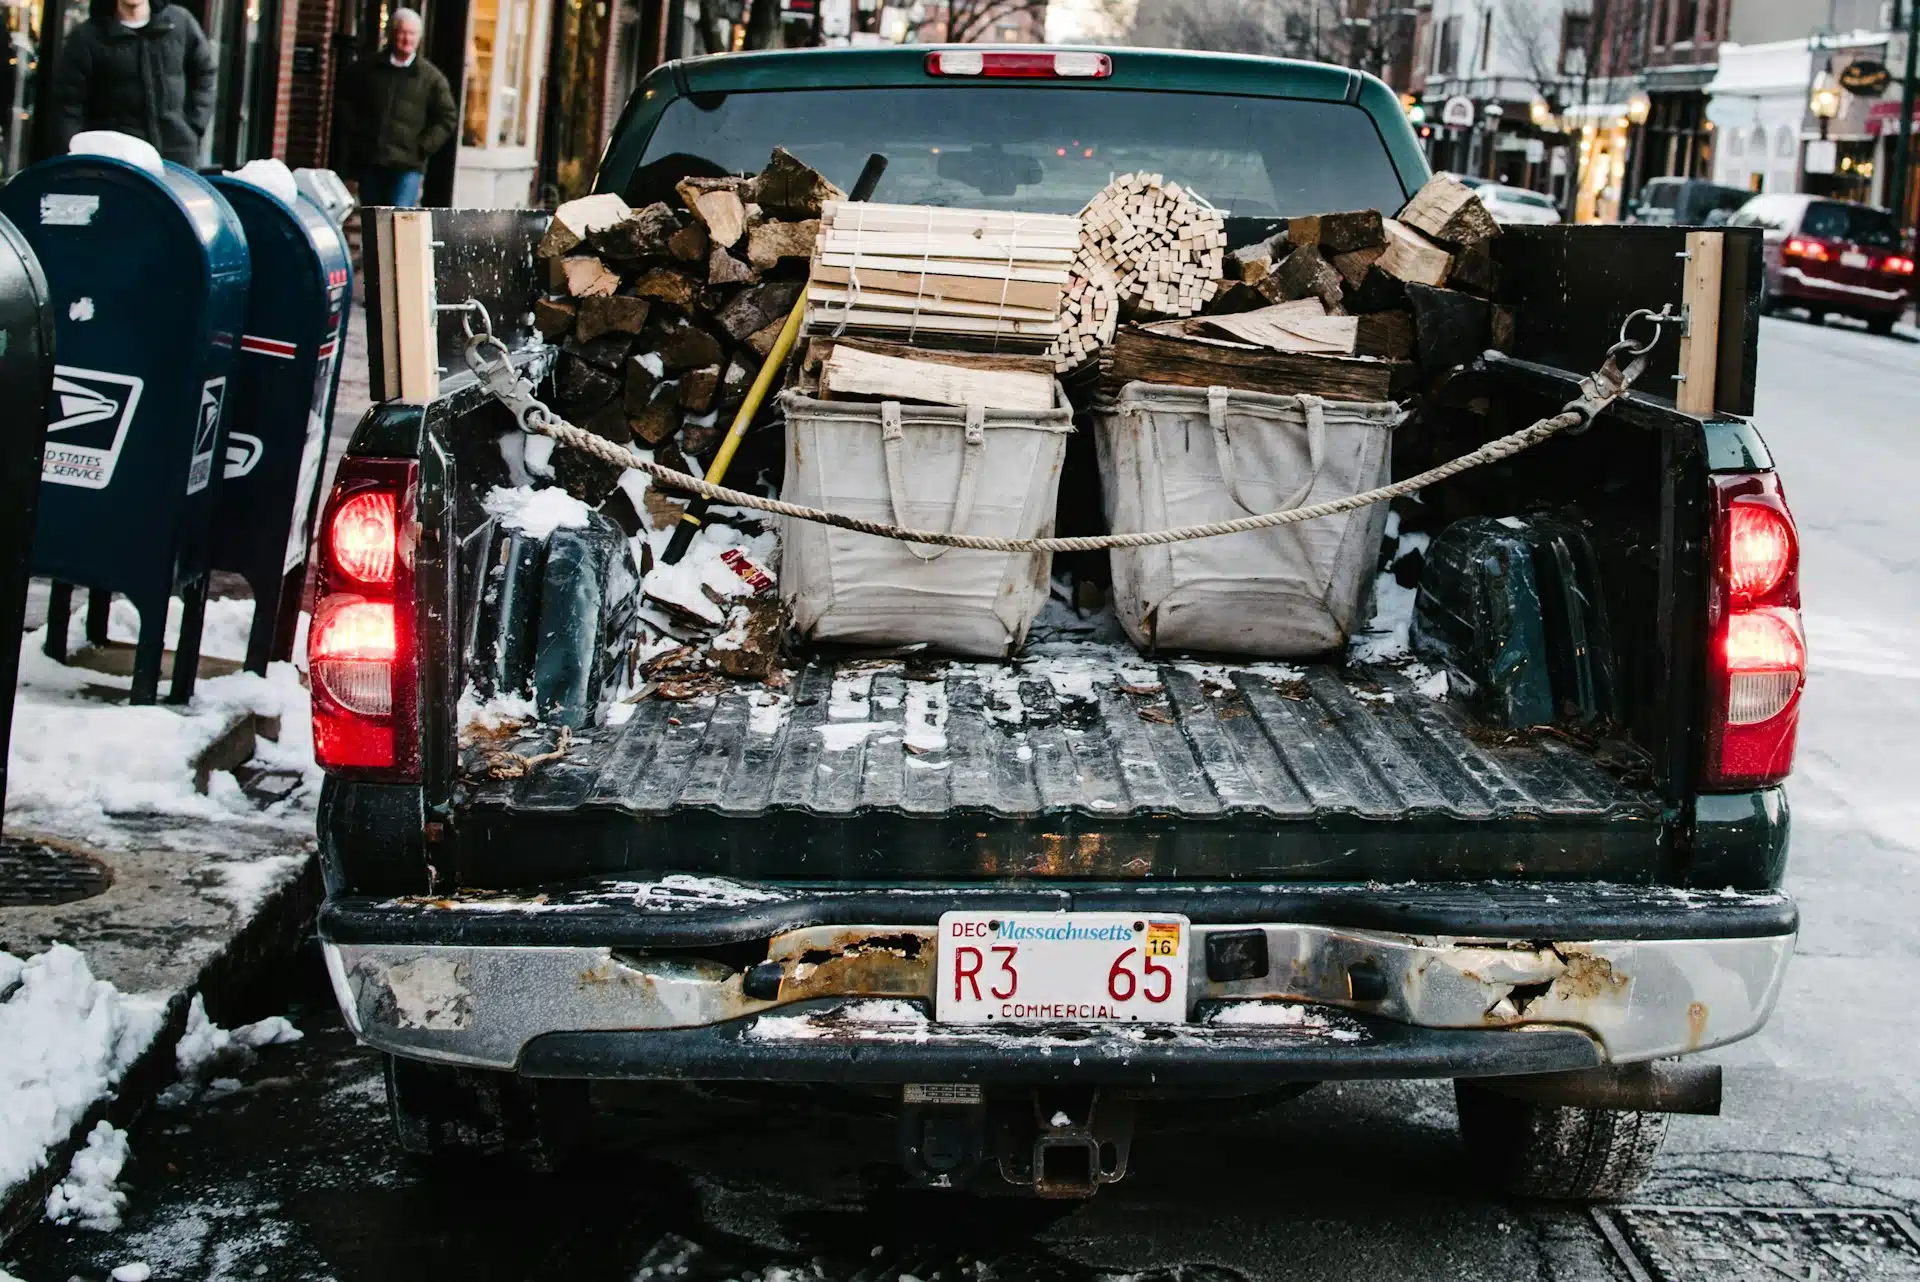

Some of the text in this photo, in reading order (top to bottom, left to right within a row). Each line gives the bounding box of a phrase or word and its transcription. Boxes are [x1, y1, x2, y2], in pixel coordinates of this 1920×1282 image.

[59, 451, 102, 467] STATES
[53, 465, 105, 480] SERVICE
[953, 922, 987, 937] DEC
[996, 919, 1133, 941] Massachusetts
[1150, 939, 1171, 955] 16
[955, 946, 1172, 1003] R3 65
[1002, 1004, 1121, 1019] COMMERCIAL
